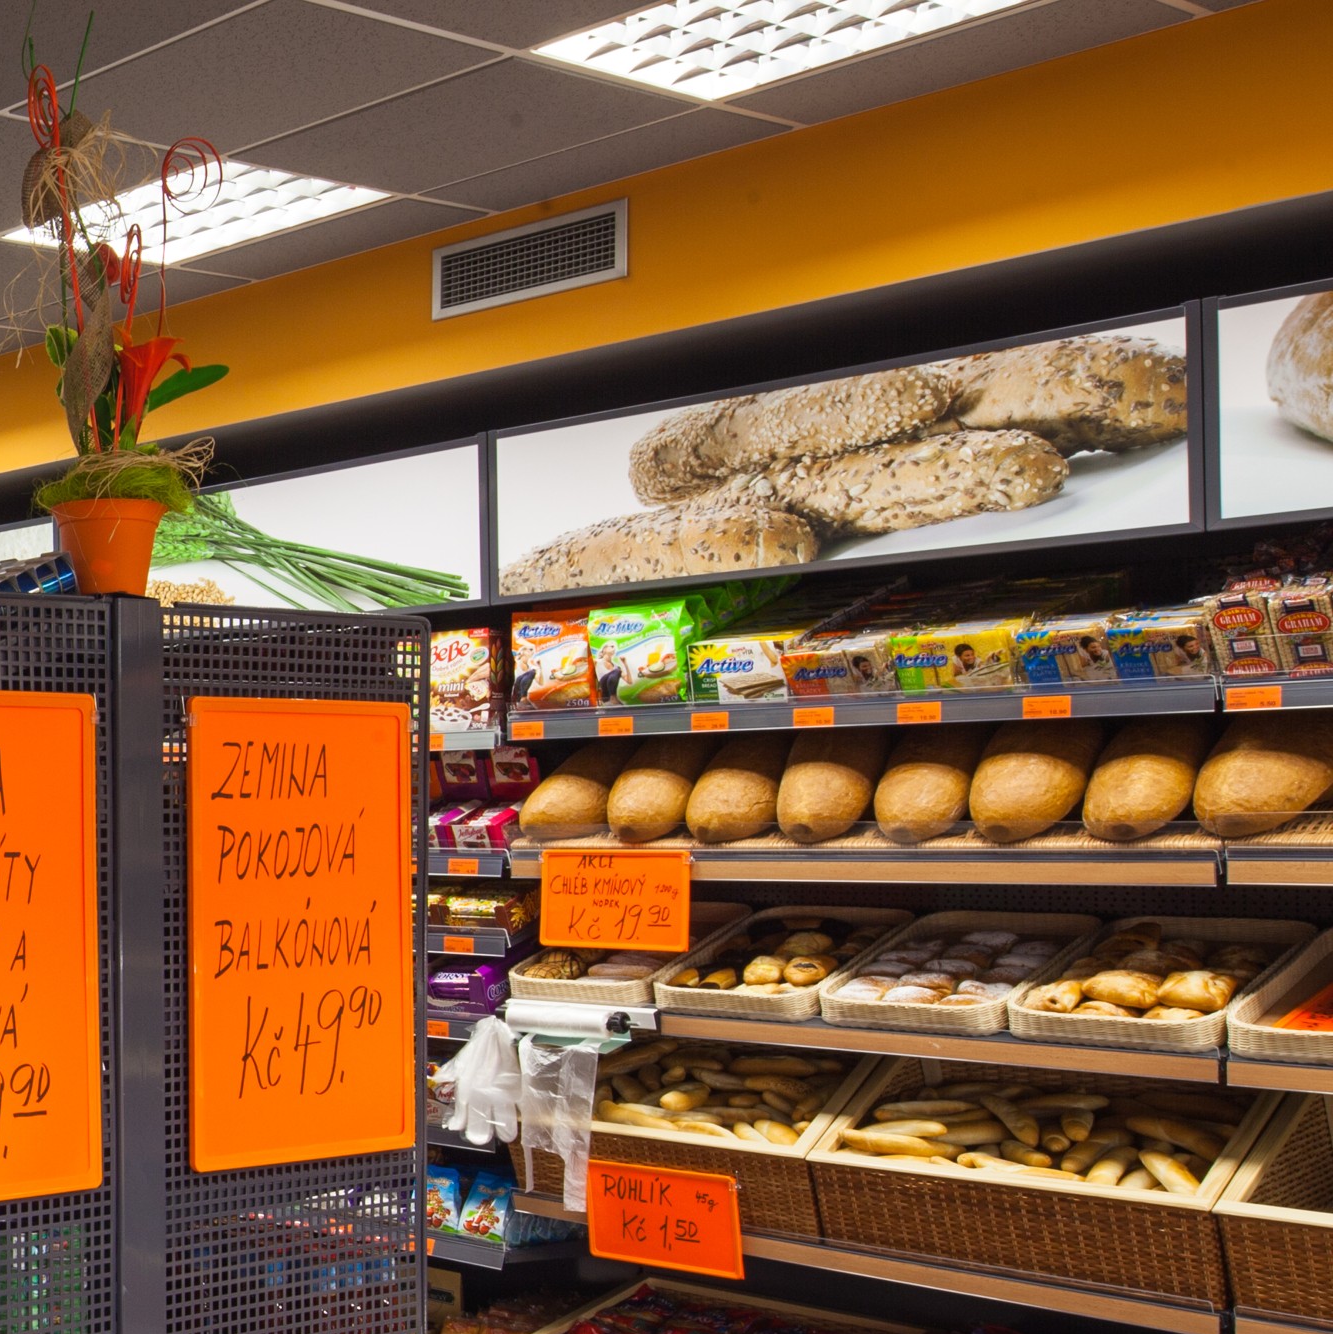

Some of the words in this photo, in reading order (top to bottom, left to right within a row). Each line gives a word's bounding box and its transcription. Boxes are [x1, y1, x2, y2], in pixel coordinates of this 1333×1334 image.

[594, 618, 644, 636] Active
[1219, 612, 1257, 625] GRAHAM
[1284, 617, 1324, 630] GRAHAM
[518, 622, 561, 640] Active
[696, 656, 754, 675] Active
[895, 652, 949, 669] Active
[794, 664, 848, 682] Active
[438, 679, 465, 694] mini
[210, 740, 327, 802] ZEMINA
[217, 808, 364, 883] POKOJOVÁ
[577, 854, 615, 870] AKCE
[549, 870, 589, 897] CHLÉB
[593, 873, 648, 897] KMÍNOVÝ
[568, 905, 602, 941] Kč
[214, 898, 377, 979] BALKÓNOVÁ
[10, 930, 28, 972] A
[239, 995, 284, 1099] Kč
[601, 1173, 671, 1207] ROHLÍK
[621, 1214, 647, 1244] Kč
